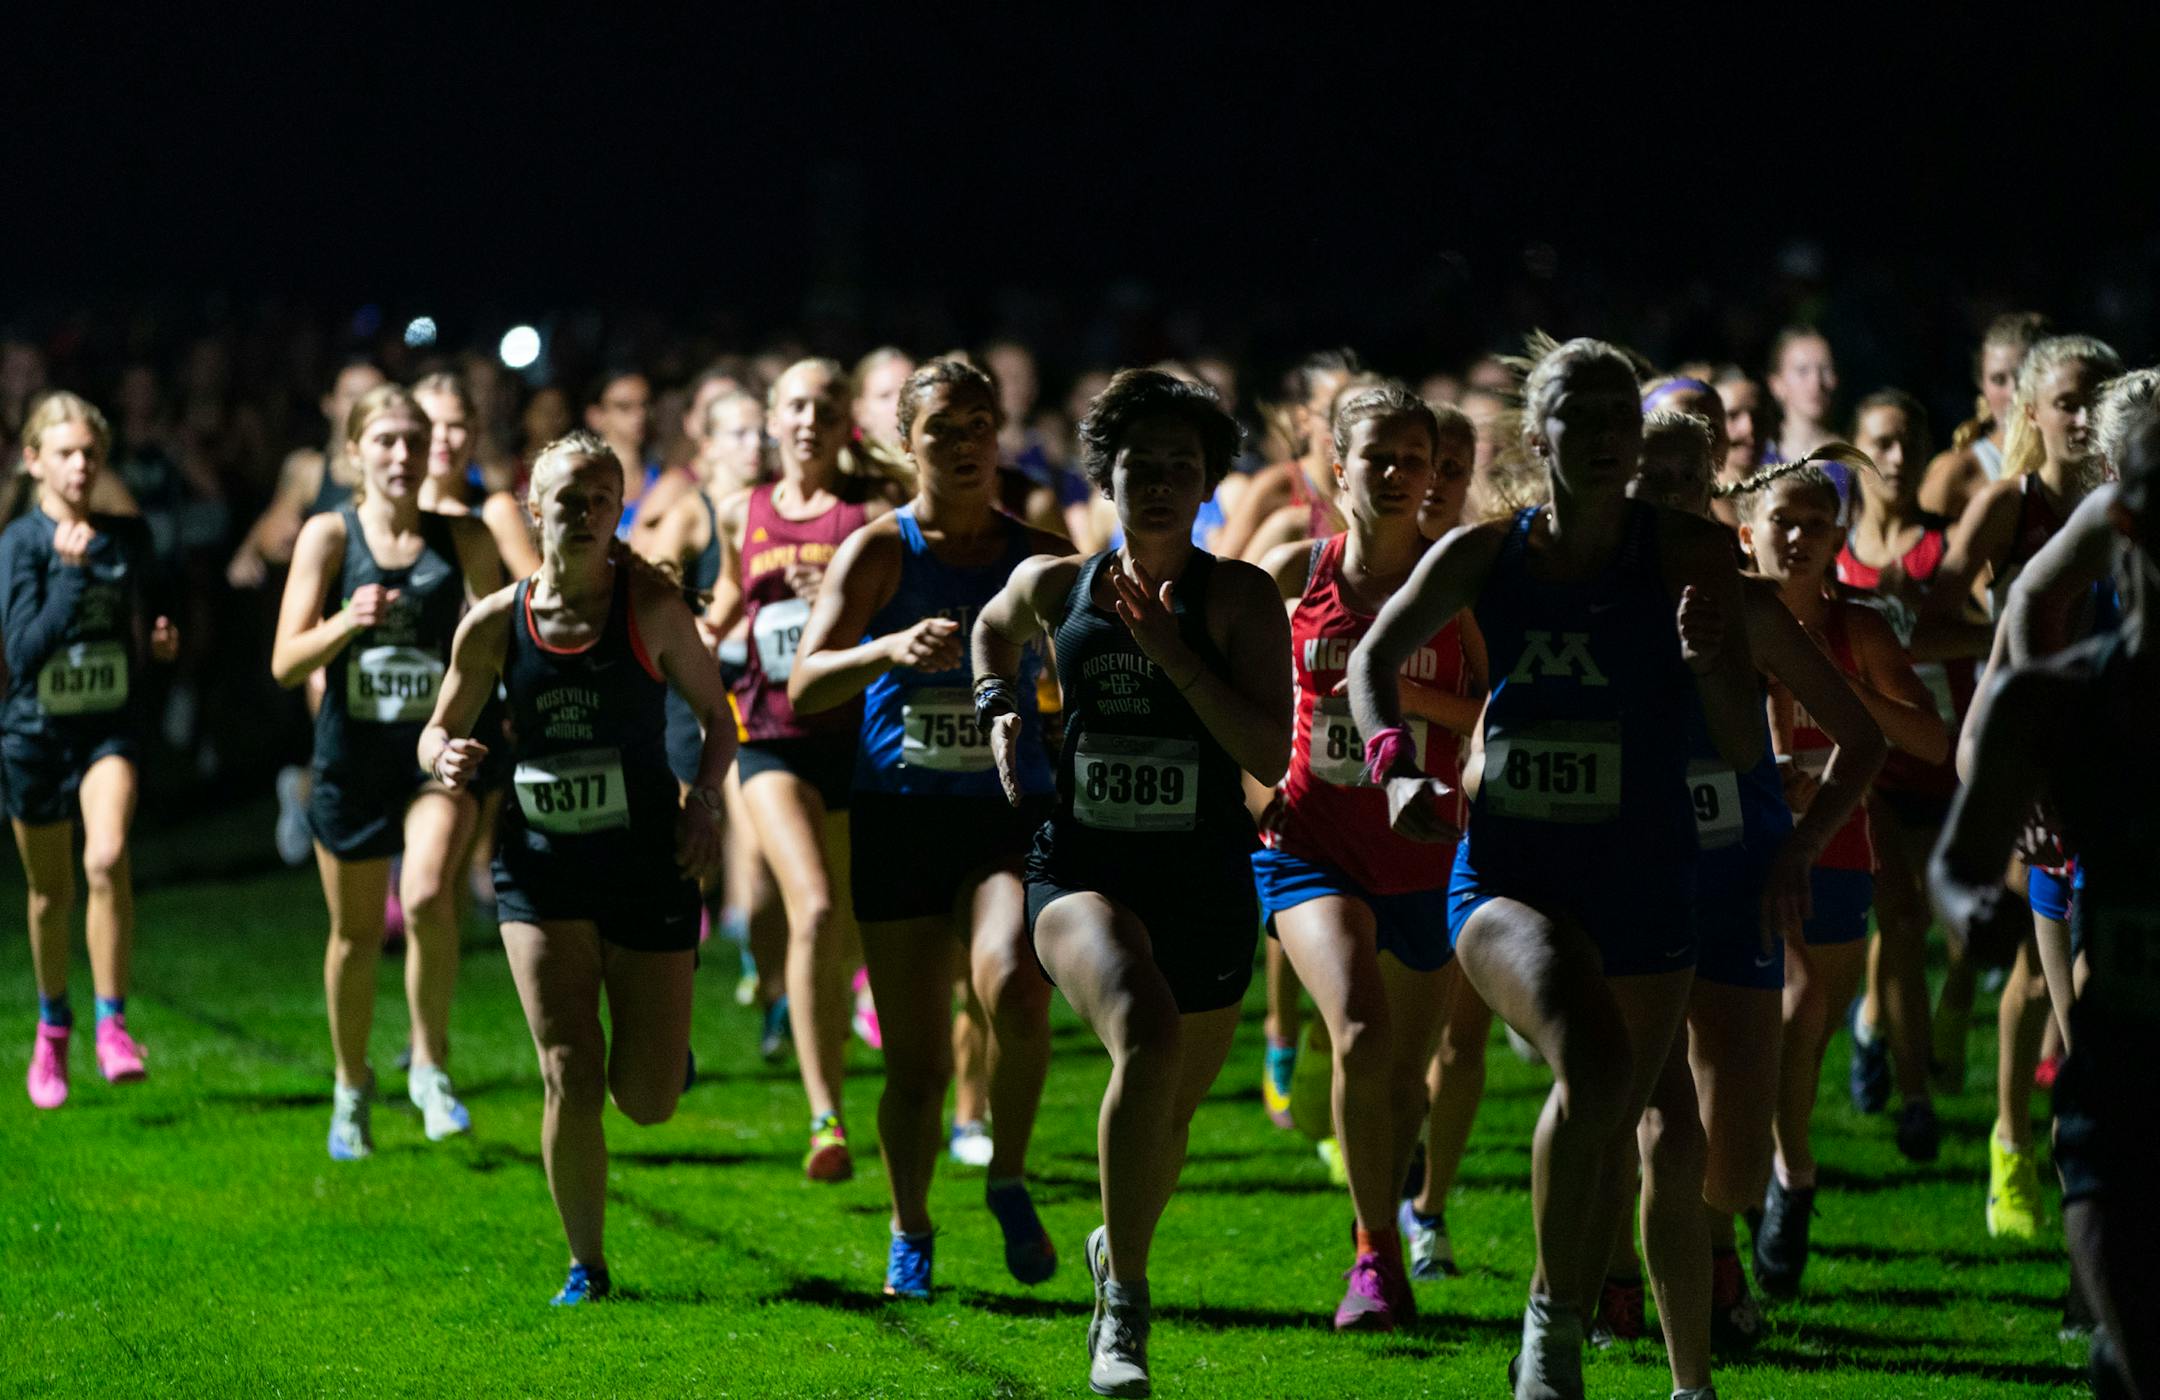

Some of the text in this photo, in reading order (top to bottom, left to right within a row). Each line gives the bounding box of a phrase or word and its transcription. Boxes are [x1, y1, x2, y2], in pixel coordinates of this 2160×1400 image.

[1082, 652, 1154, 680] ROSEVILLE
[1508, 629, 1609, 687] M
[359, 672, 431, 697] 8380
[536, 687, 601, 714] ROSEVILLE
[1097, 697, 1151, 716] RAIDERS
[1086, 762, 1184, 805] 8389
[1507, 749, 1597, 794] 8151
[533, 774, 606, 814] 8377
